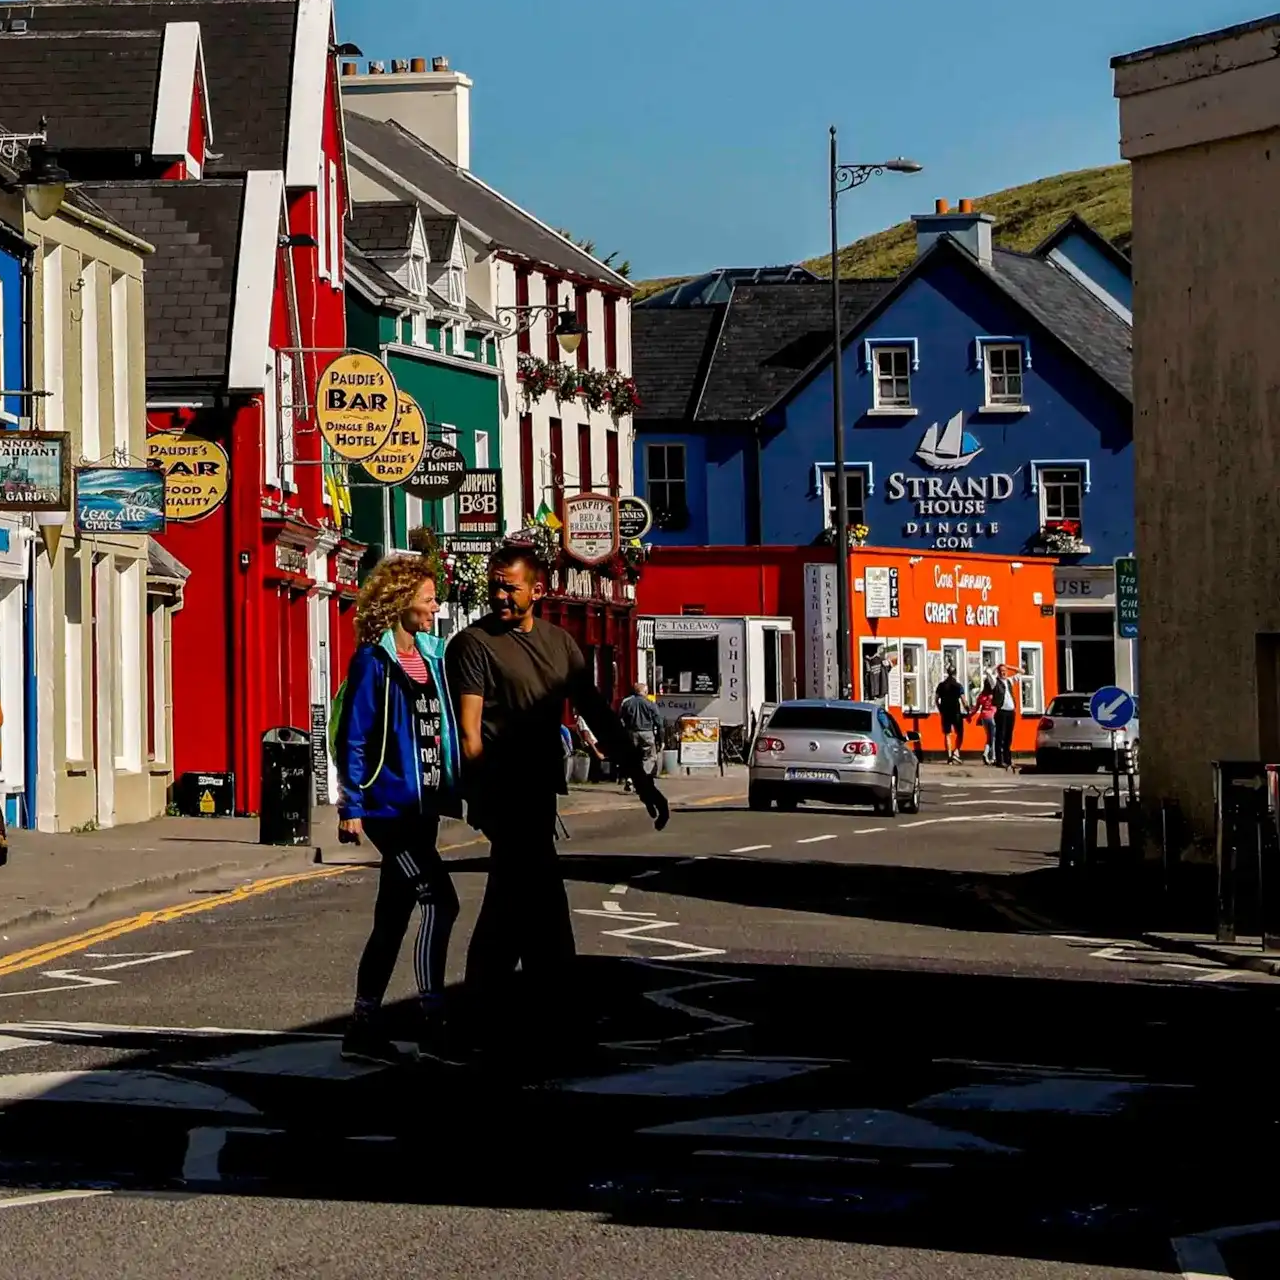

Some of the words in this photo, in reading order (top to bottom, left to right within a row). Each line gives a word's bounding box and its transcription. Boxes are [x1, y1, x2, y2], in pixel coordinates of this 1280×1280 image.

[331, 371, 384, 385] PAUDIE'S
[325, 389, 388, 411] BAR
[326, 422, 362, 431] DINGLE
[367, 422, 387, 431] BAY
[336, 434, 376, 446] HOTEL
[391, 432, 419, 444] TEL
[149, 445, 207, 455] PAUDIE'S
[377, 465, 403, 474] BAR
[428, 461, 463, 471] LINEN
[890, 472, 1013, 499] STRAND
[6, 492, 57, 501] GARDEN
[459, 494, 497, 514] B&B
[920, 500, 985, 514] HOUSE
[907, 522, 999, 533] DINGLE
[452, 542, 491, 552] VACANCIES
[931, 537, 974, 549] .COM
[890, 568, 898, 616] GIFTS
[1054, 580, 1092, 595] USE
[925, 602, 958, 624] CRAFT
[966, 604, 975, 625] &
[977, 605, 999, 627] GIFT
[729, 636, 738, 701] CHIPS
